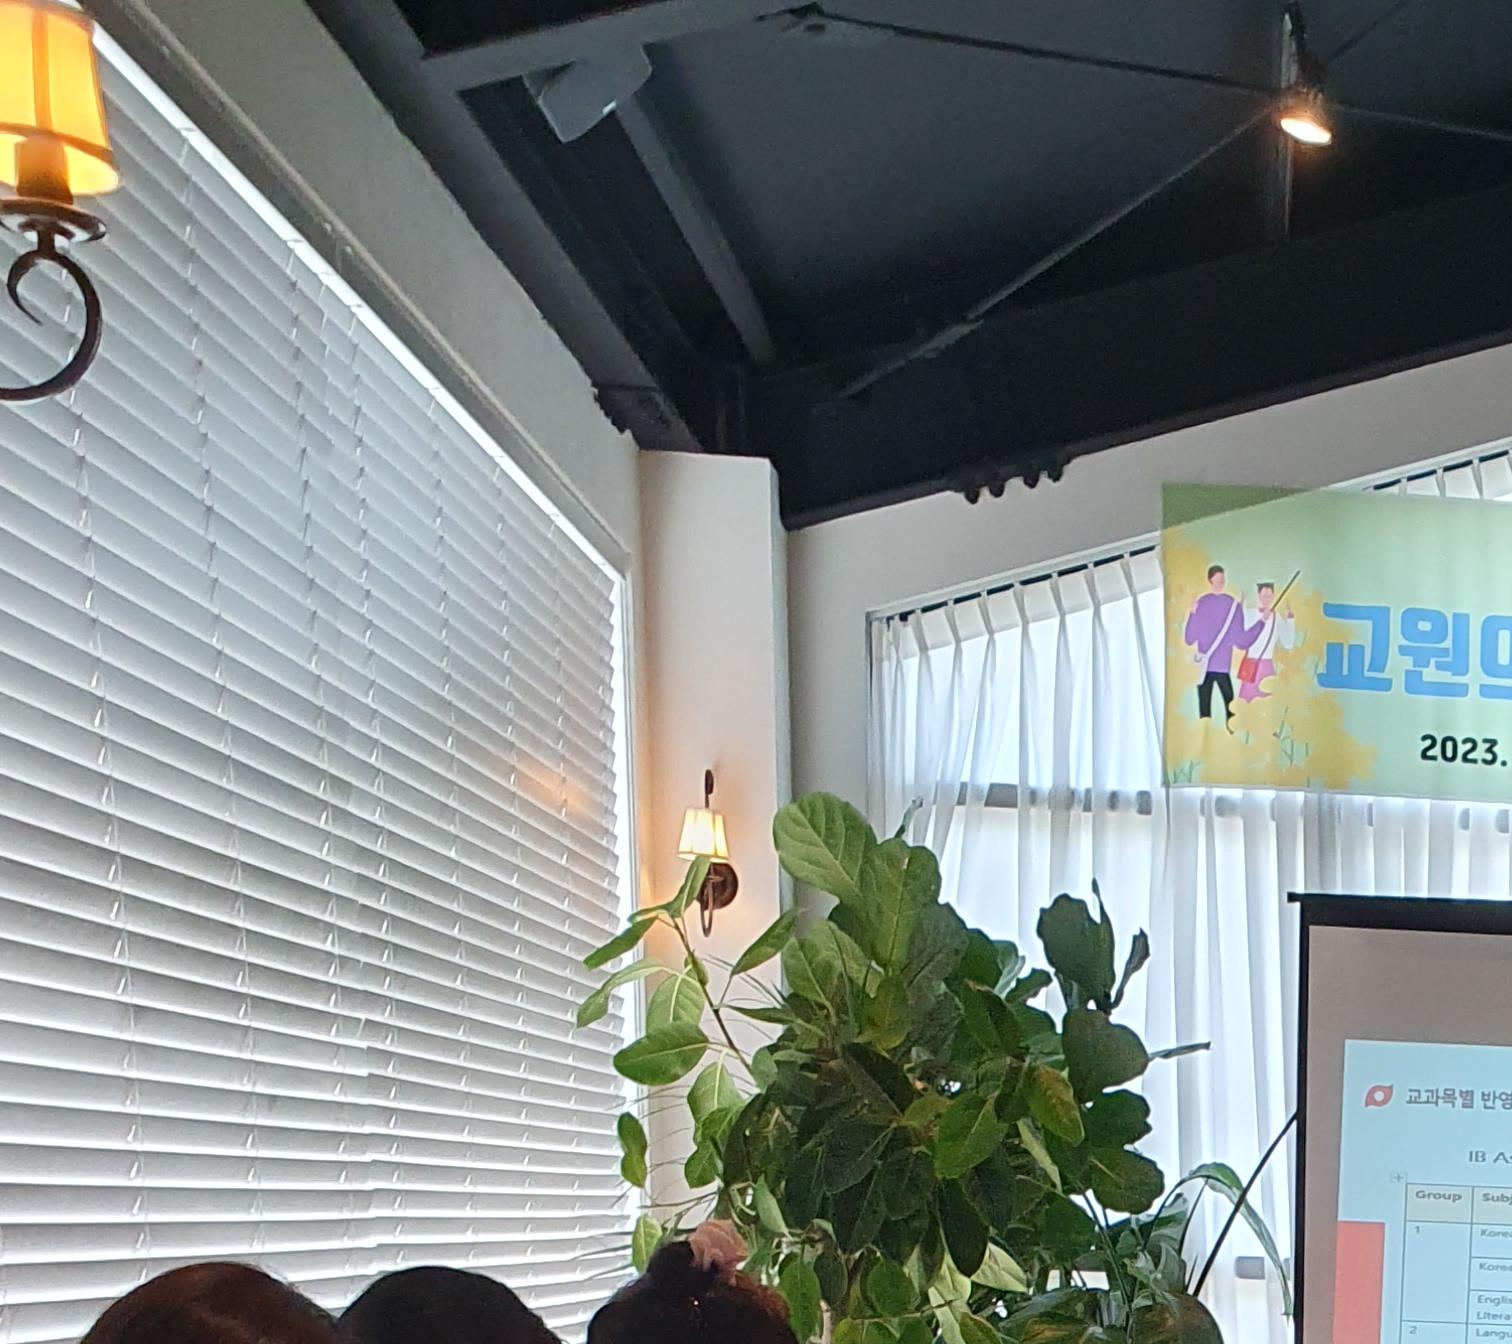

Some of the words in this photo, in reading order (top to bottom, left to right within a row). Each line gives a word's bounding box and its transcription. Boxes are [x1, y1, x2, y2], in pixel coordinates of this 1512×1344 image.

[1420, 733, 1507, 767] 2023.
[1405, 1087, 1474, 1110] 교과목별
[1468, 1150, 1486, 1163] IB
[1415, 1190, 1462, 1204] Group
[1414, 1226, 1421, 1235] 1
[1409, 1325, 1418, 1335] 2
